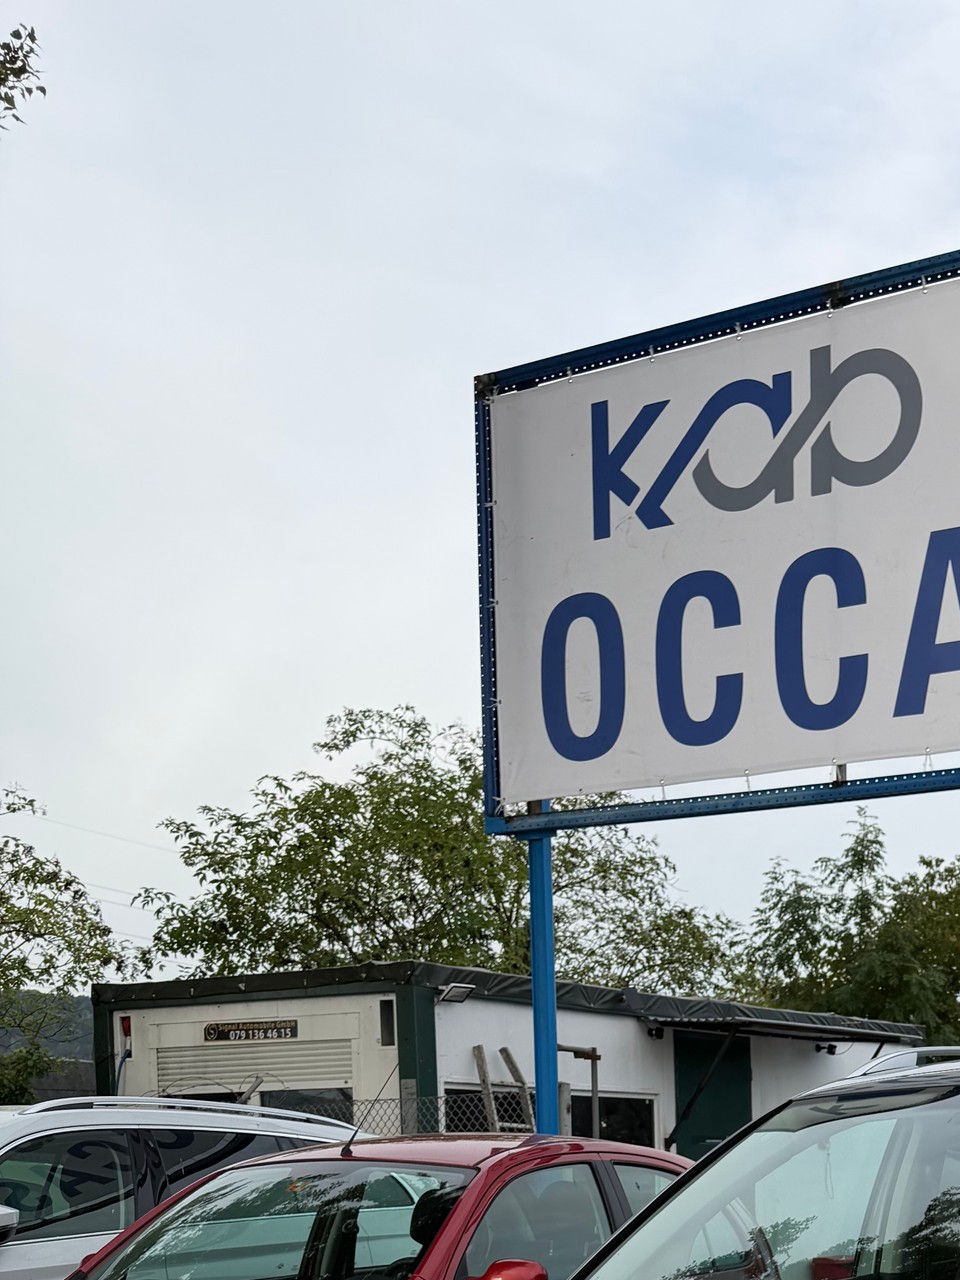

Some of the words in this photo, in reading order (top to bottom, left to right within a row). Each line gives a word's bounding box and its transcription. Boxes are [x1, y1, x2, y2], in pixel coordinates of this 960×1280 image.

[229, 1030, 246, 1040] 079
[249, 1029, 265, 1039] 136
[266, 1029, 278, 1038] 46
[280, 1028, 292, 1037] 15
